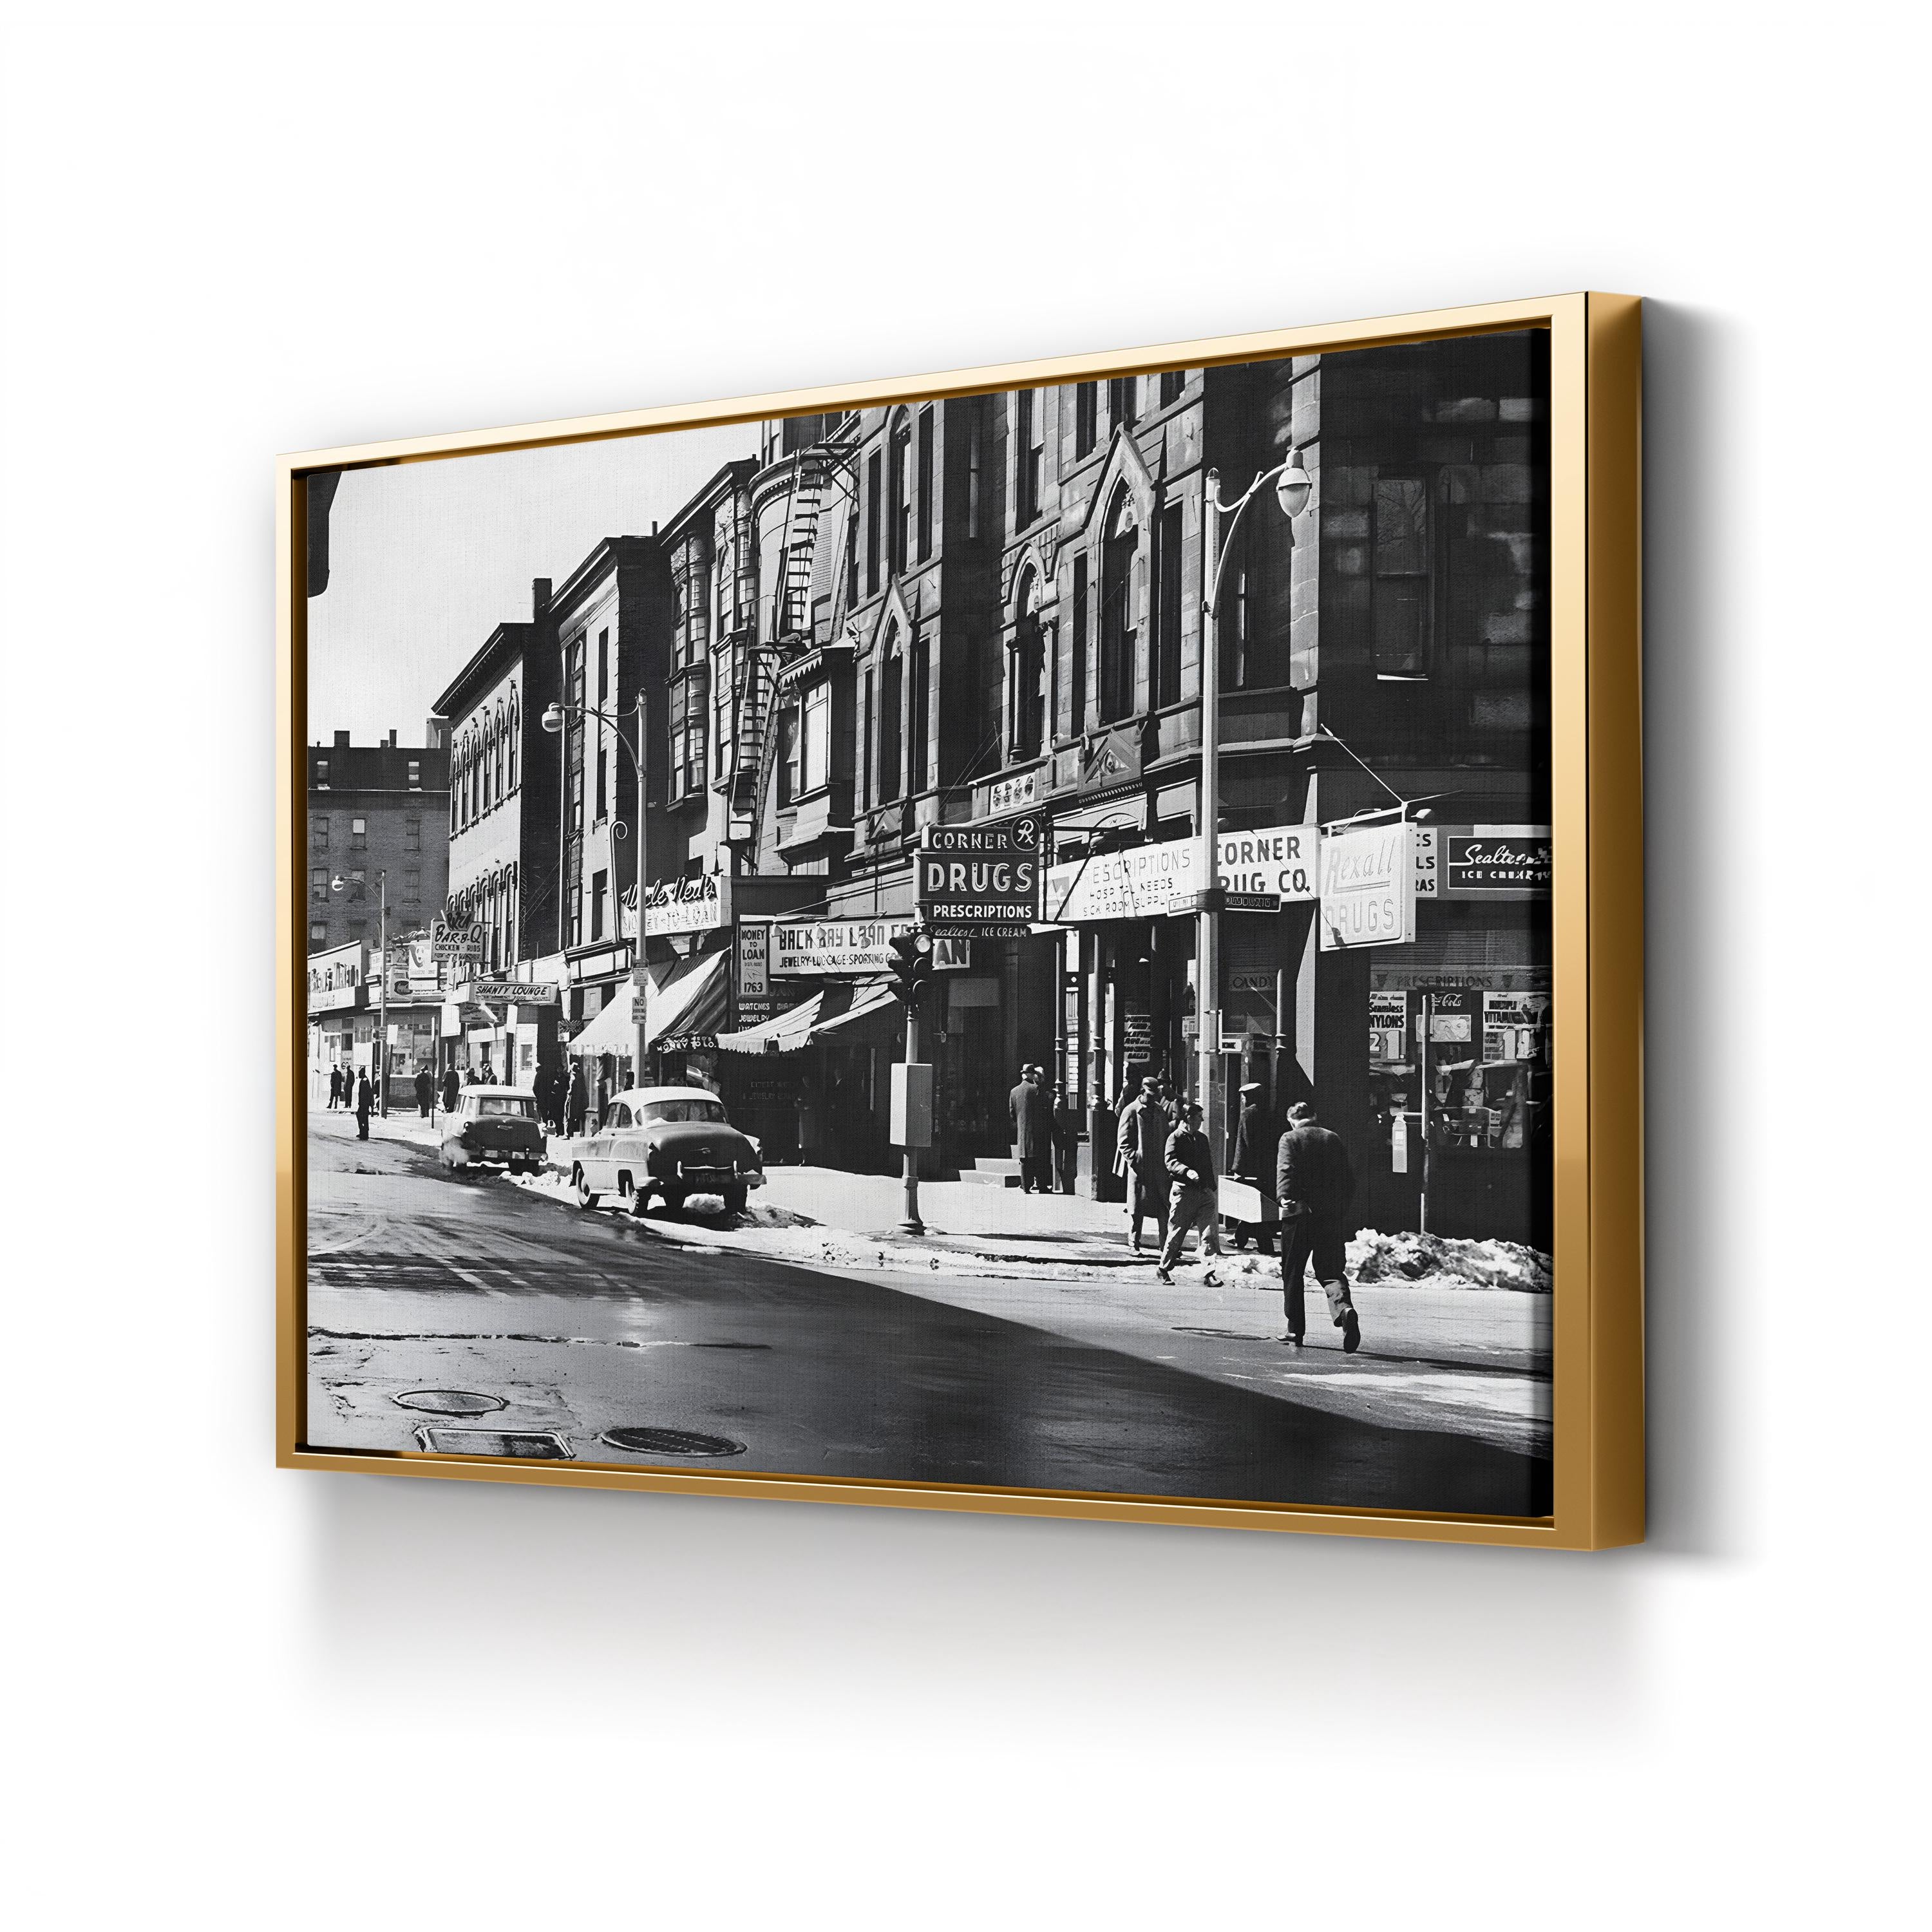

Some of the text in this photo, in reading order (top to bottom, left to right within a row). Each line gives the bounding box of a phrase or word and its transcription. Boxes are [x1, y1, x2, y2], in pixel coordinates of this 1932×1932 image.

[933, 833, 1008, 849] CORNER
[1217, 836, 1301, 866] CORNER
[1076, 848, 1190, 884] ESCRIPTIONS
[1324, 836, 1396, 896] Rexall
[927, 862, 1033, 892] DRUGS
[1217, 872, 1266, 893] RUG
[621, 878, 670, 908] Ucle
[933, 905, 1032, 918] PRESCRIPTIONS
[1326, 898, 1394, 936] DRUGS
[741, 929, 766, 940] MONEY
[779, 928, 813, 951] BACK
[981, 927, 994, 936] ICE
[998, 927, 1027, 937] CREAM
[742, 949, 765, 960] LOAN
[512, 986, 549, 996] LOUNGE
[744, 981, 763, 993] 1763
